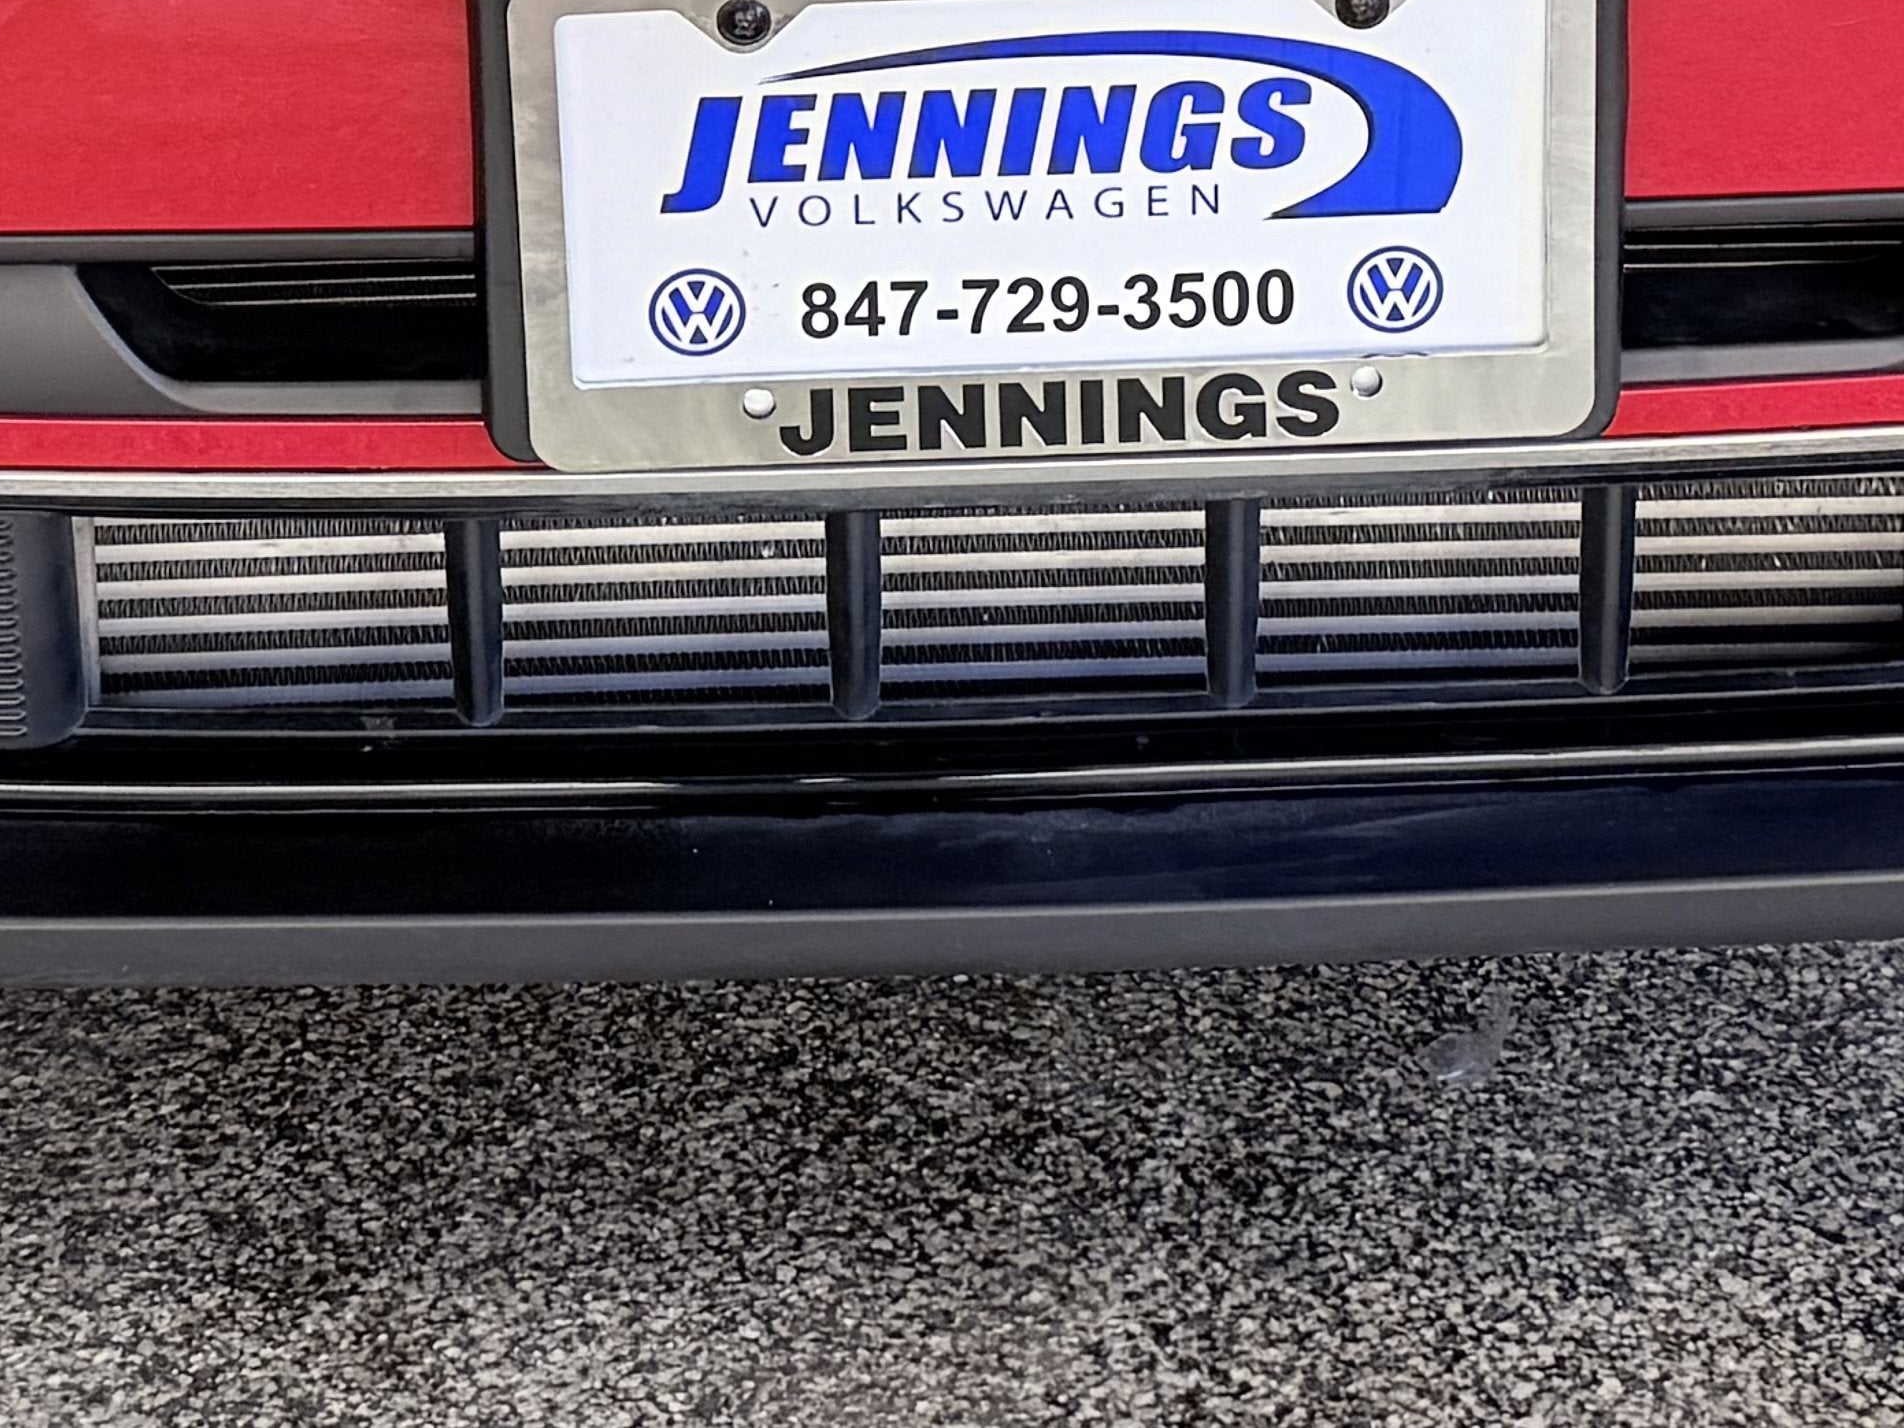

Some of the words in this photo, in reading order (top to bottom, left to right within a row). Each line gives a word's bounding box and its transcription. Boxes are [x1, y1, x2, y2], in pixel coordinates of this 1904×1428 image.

[662, 77, 1313, 214] JENNINGS
[749, 183, 1221, 228] VOLKSWAGEN
[800, 268, 1295, 339] 847-729-3500
[779, 370, 1340, 457] JENNINGS
